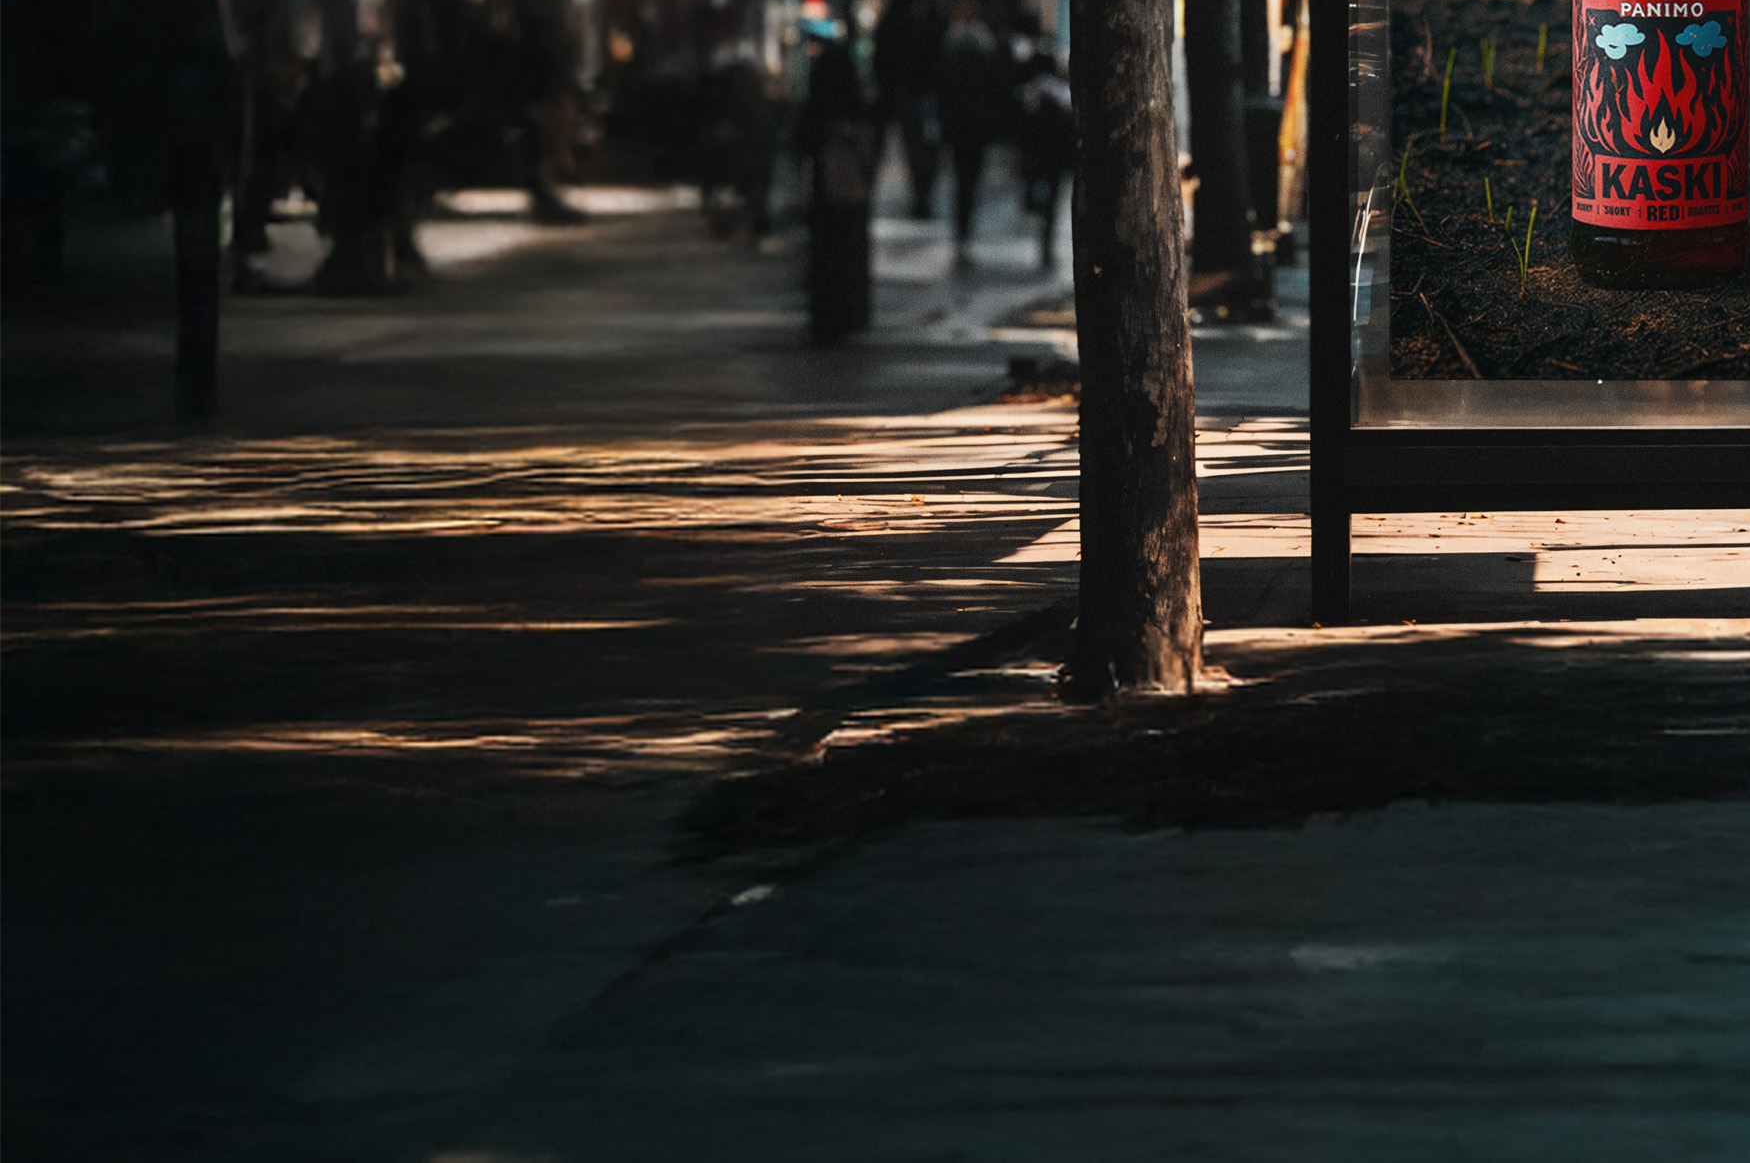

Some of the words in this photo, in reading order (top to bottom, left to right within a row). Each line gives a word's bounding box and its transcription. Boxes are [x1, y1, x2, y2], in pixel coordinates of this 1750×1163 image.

[1620, 1, 1704, 18] PANIMO
[1602, 161, 1721, 201] KASKI
[1647, 204, 1680, 221] RED
